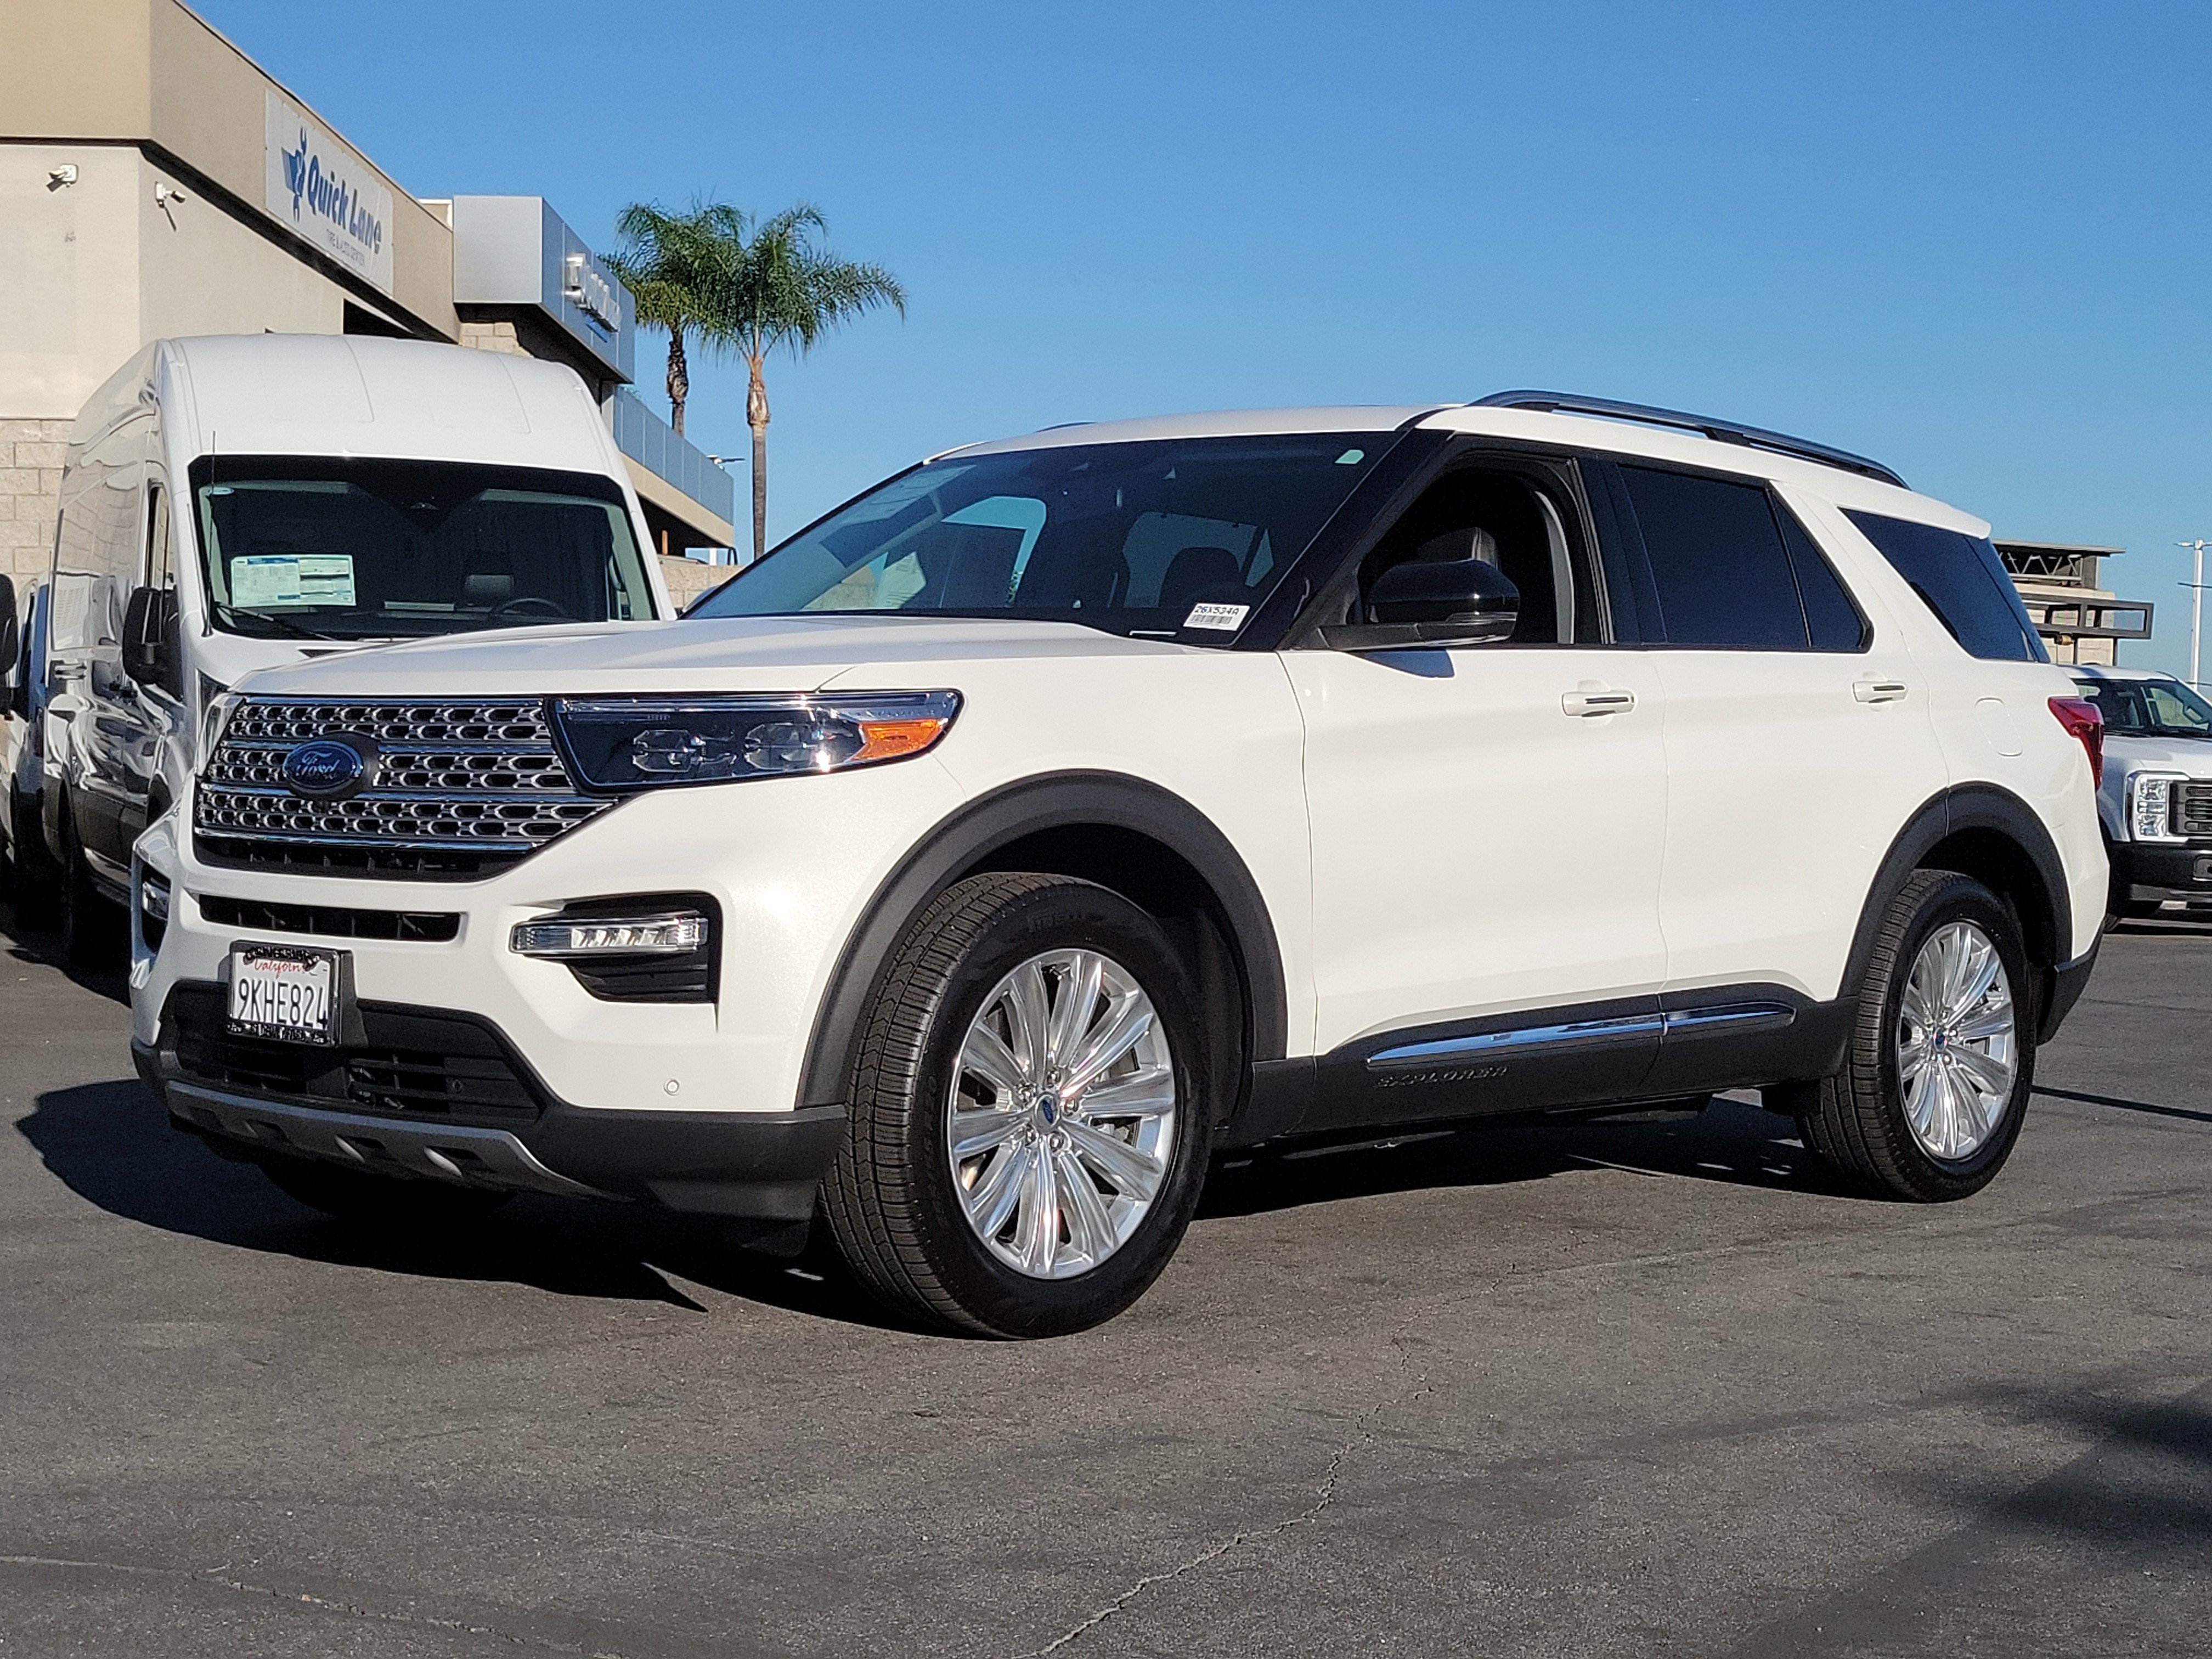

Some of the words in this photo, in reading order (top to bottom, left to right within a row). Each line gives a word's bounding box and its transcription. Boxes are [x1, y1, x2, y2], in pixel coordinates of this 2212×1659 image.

[308, 155, 348, 230] Quick
[349, 189, 381, 255] Lane
[296, 751, 341, 778] Ford
[238, 978, 329, 1030] 9KHE824
